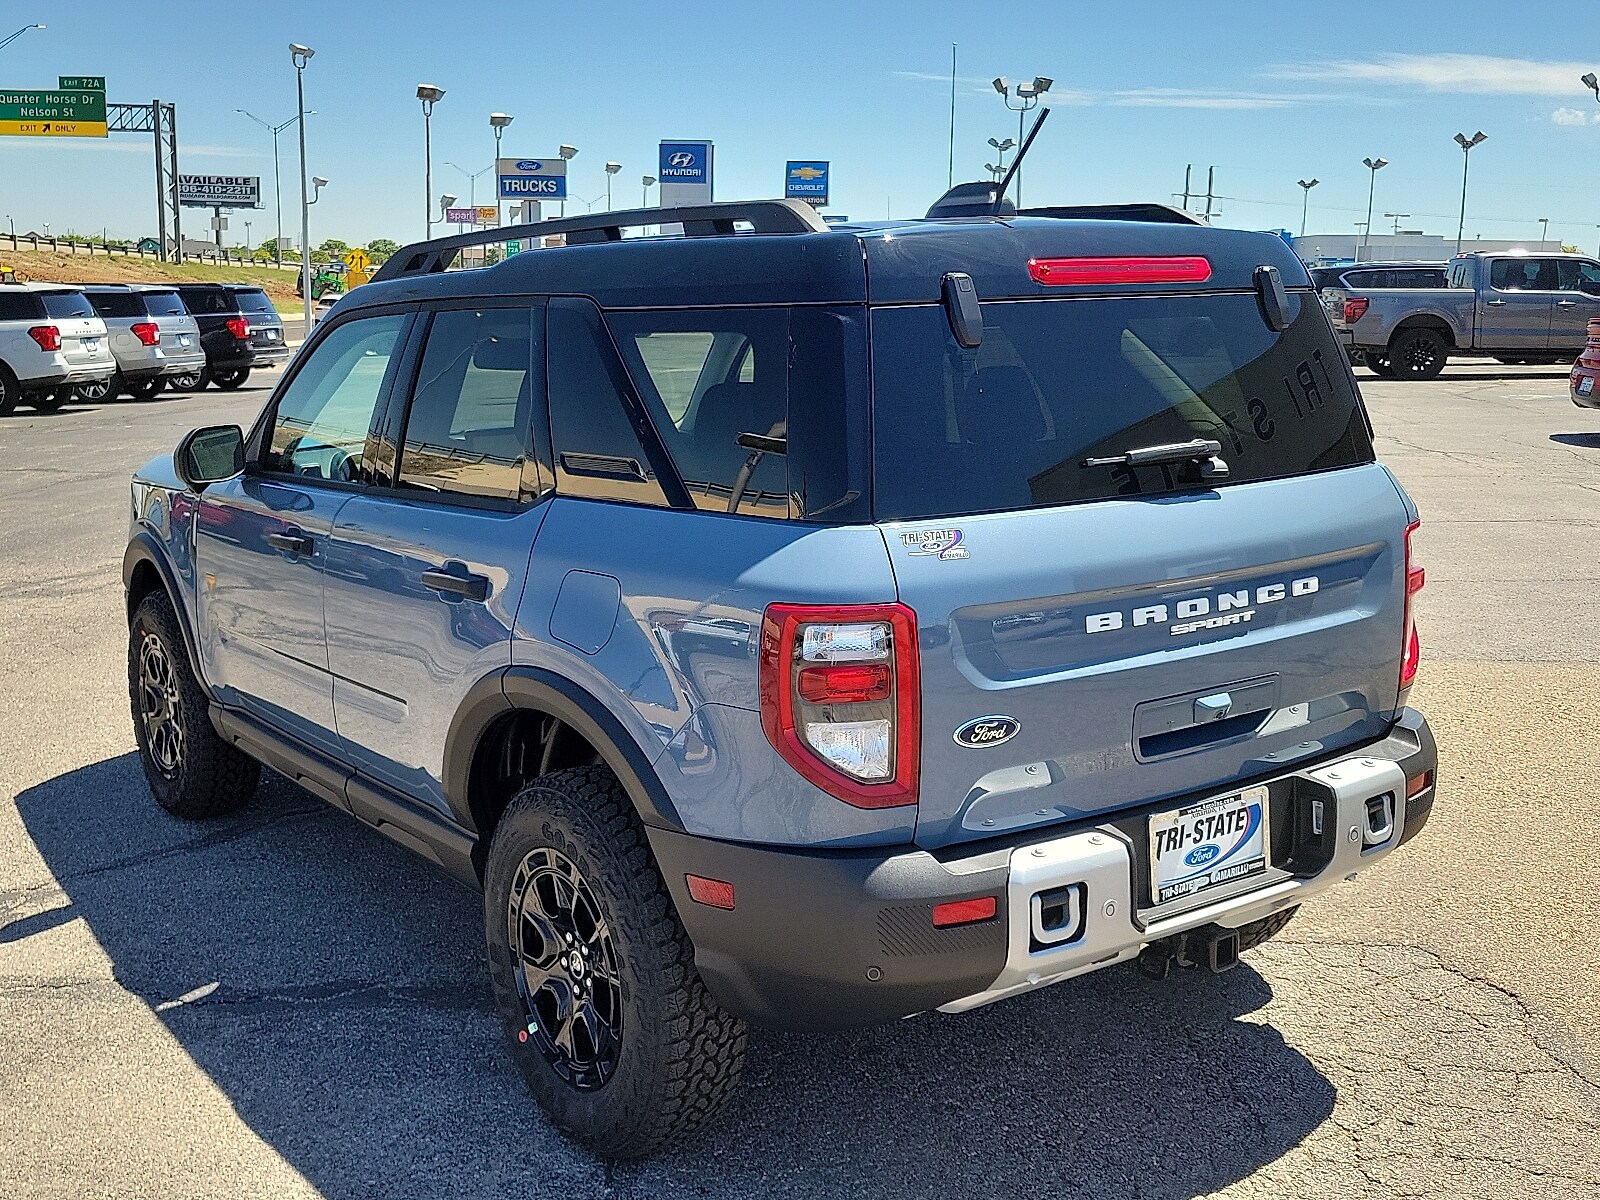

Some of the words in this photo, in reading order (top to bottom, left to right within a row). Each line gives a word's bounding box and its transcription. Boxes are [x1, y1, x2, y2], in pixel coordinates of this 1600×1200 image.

[64, 79, 78, 87] EXIT
[82, 79, 100, 88] 72A
[0, 94, 40, 104] Quarter
[45, 94, 77, 104] Horse
[82, 95, 95, 105] Dr
[20, 107, 58, 117] Nelson
[63, 107, 75, 117] St
[20, 124, 37, 132] EXIT
[55, 125, 77, 133] ONLY
[662, 168, 702, 177] HYUNDAI
[179, 185, 251, 195] 06-410-2211
[503, 179, 557, 193] TRUCKS
[449, 210, 475, 222] spark
[899, 530, 954, 546] TRI-STATE
[1086, 576, 1320, 634] BRONCO
[1170, 609, 1257, 636] SPORT
[970, 721, 1008, 743] Ford
[1155, 807, 1247, 862] TRI-STATE
[1160, 881, 1195, 902] TRI-STATE
